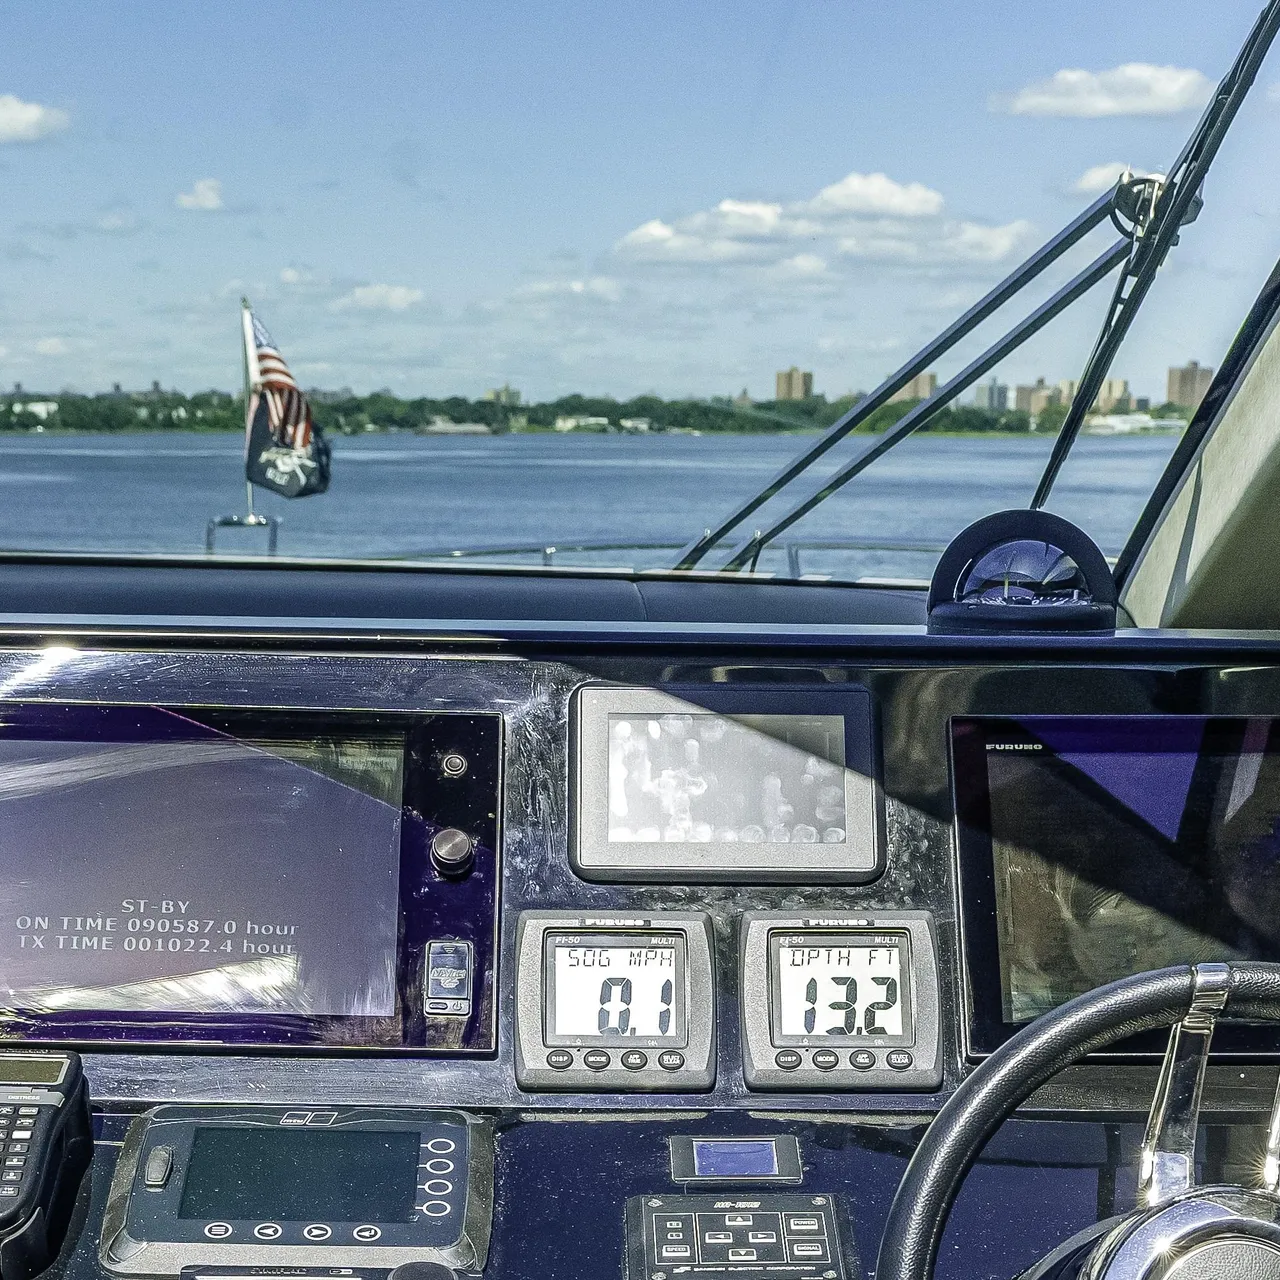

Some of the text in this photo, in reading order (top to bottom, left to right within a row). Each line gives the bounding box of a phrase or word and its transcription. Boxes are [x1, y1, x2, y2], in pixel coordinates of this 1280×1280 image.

[121, 899, 190, 914] ST-BY
[16, 915, 299, 936] ON TIME 090587.0 hour
[19, 934, 296, 955] TX TIME 001022.4 hour
[555, 936, 581, 944] FI-50
[650, 937, 676, 945] MULTI
[568, 949, 673, 967] SOG MPH
[790, 949, 894, 967] DPTH FT
[598, 977, 673, 1036] 0.1
[804, 976, 897, 1035] 13.2
